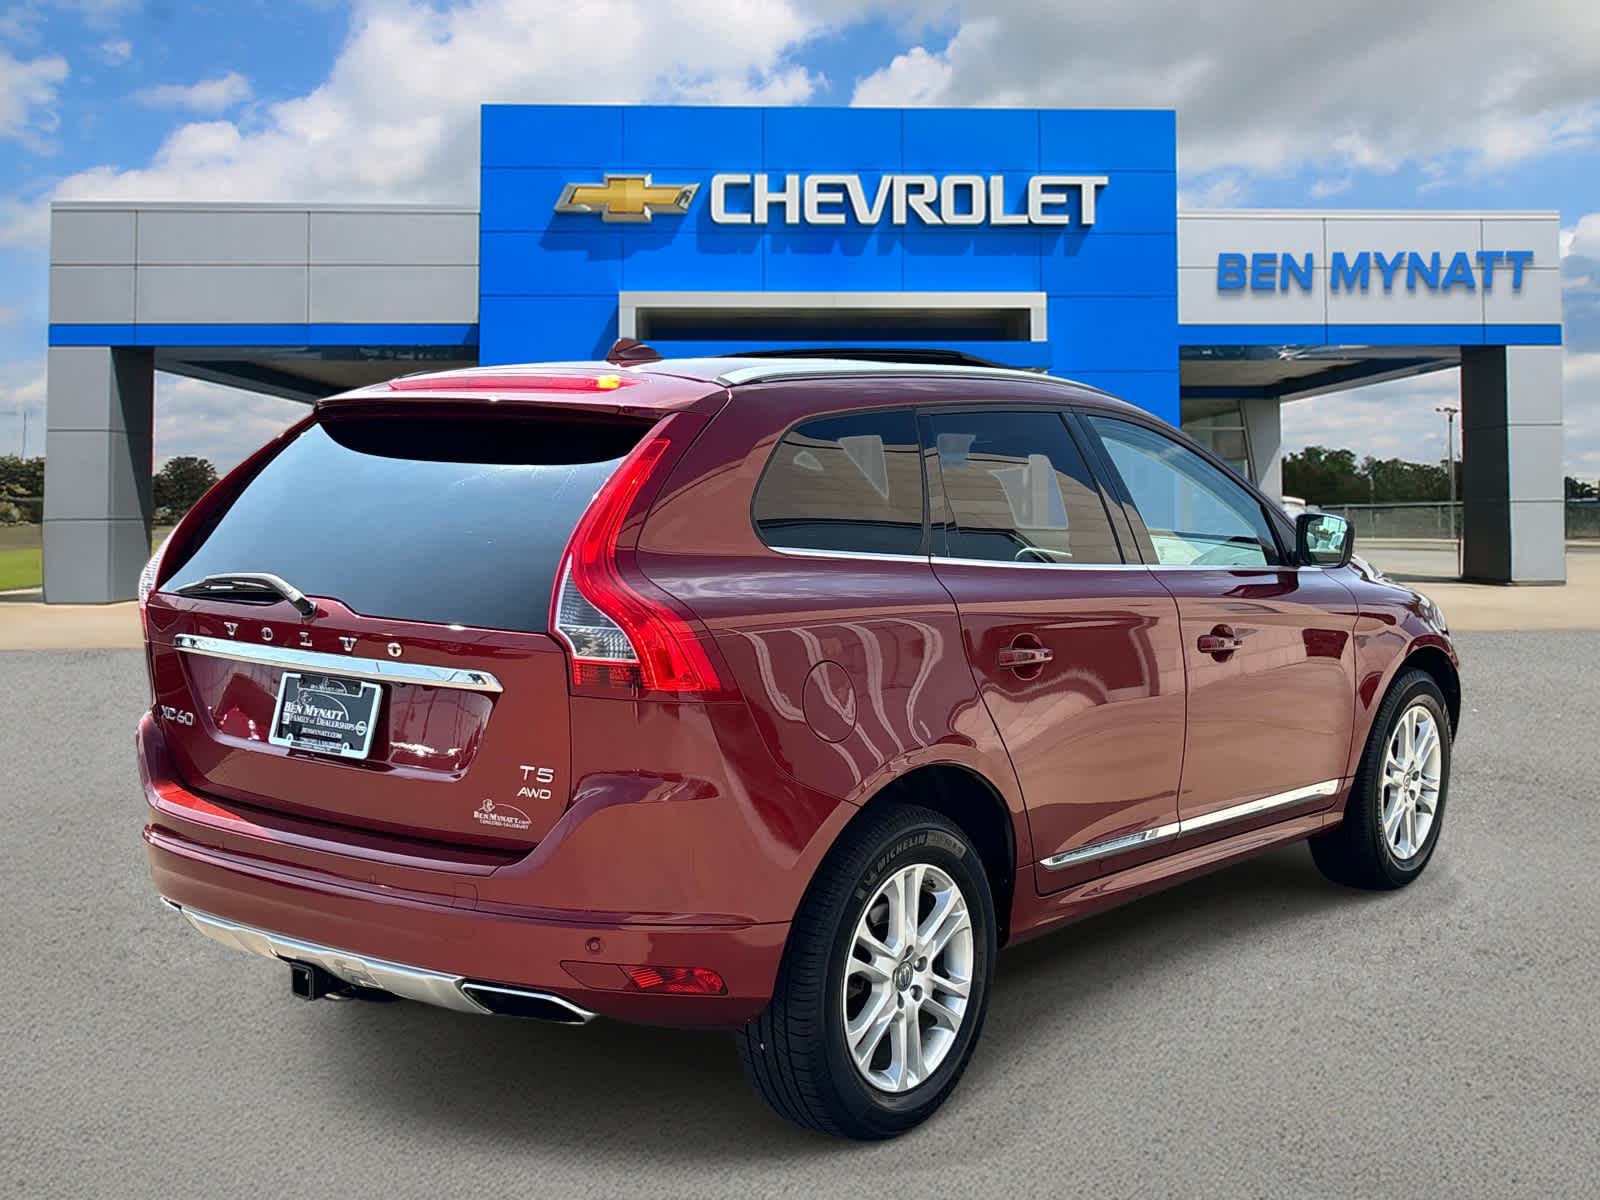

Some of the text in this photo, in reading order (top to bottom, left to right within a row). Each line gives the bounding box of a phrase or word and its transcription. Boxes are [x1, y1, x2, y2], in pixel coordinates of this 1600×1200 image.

[711, 173, 1109, 226] CHEVROLET
[1217, 250, 1534, 290] BEN MYNATT
[223, 621, 403, 657] VOLVO
[160, 704, 194, 726] XC60
[284, 701, 345, 721] BEN MYNATT
[519, 764, 554, 784] T5
[516, 786, 552, 800] AWD
[877, 832, 928, 873] MICHELIN
